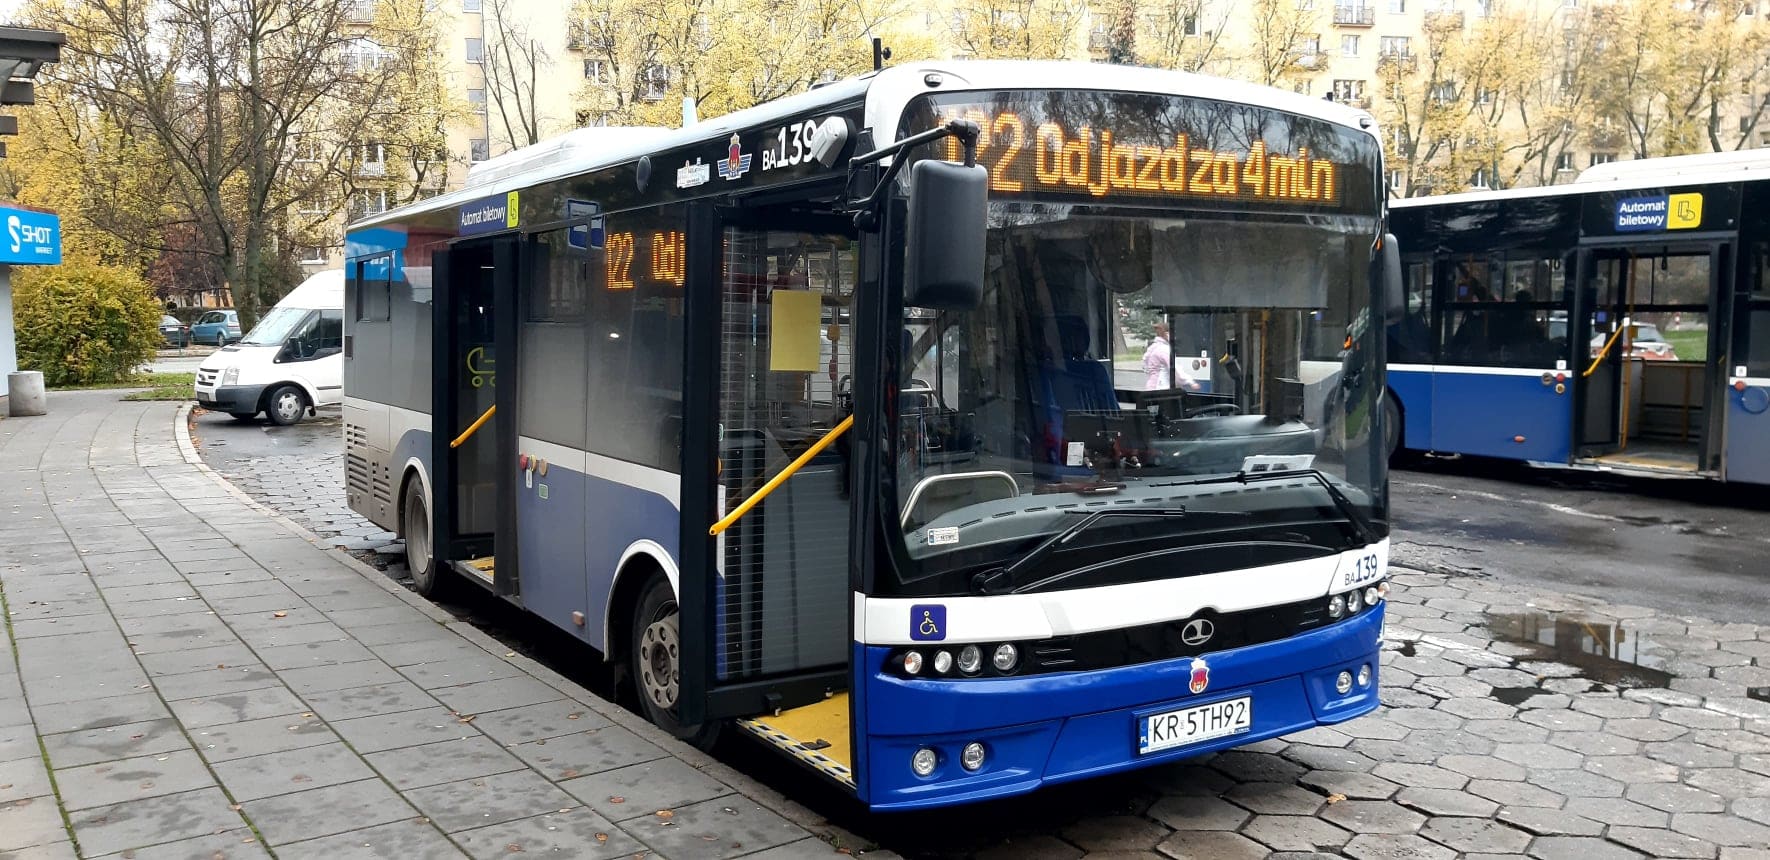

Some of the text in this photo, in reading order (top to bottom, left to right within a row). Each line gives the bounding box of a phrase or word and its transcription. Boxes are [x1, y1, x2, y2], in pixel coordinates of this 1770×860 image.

[1242, 140, 1265, 196] 4
[1269, 147, 1334, 200] min
[461, 206, 506, 226] Automat biletowy
[1620, 201, 1666, 213] Automat
[1619, 214, 1665, 227] biletowy
[21, 224, 52, 244] SHOT
[605, 231, 634, 288] 122
[1153, 714, 1178, 742] KR
[1187, 701, 1246, 735] 5TH92
